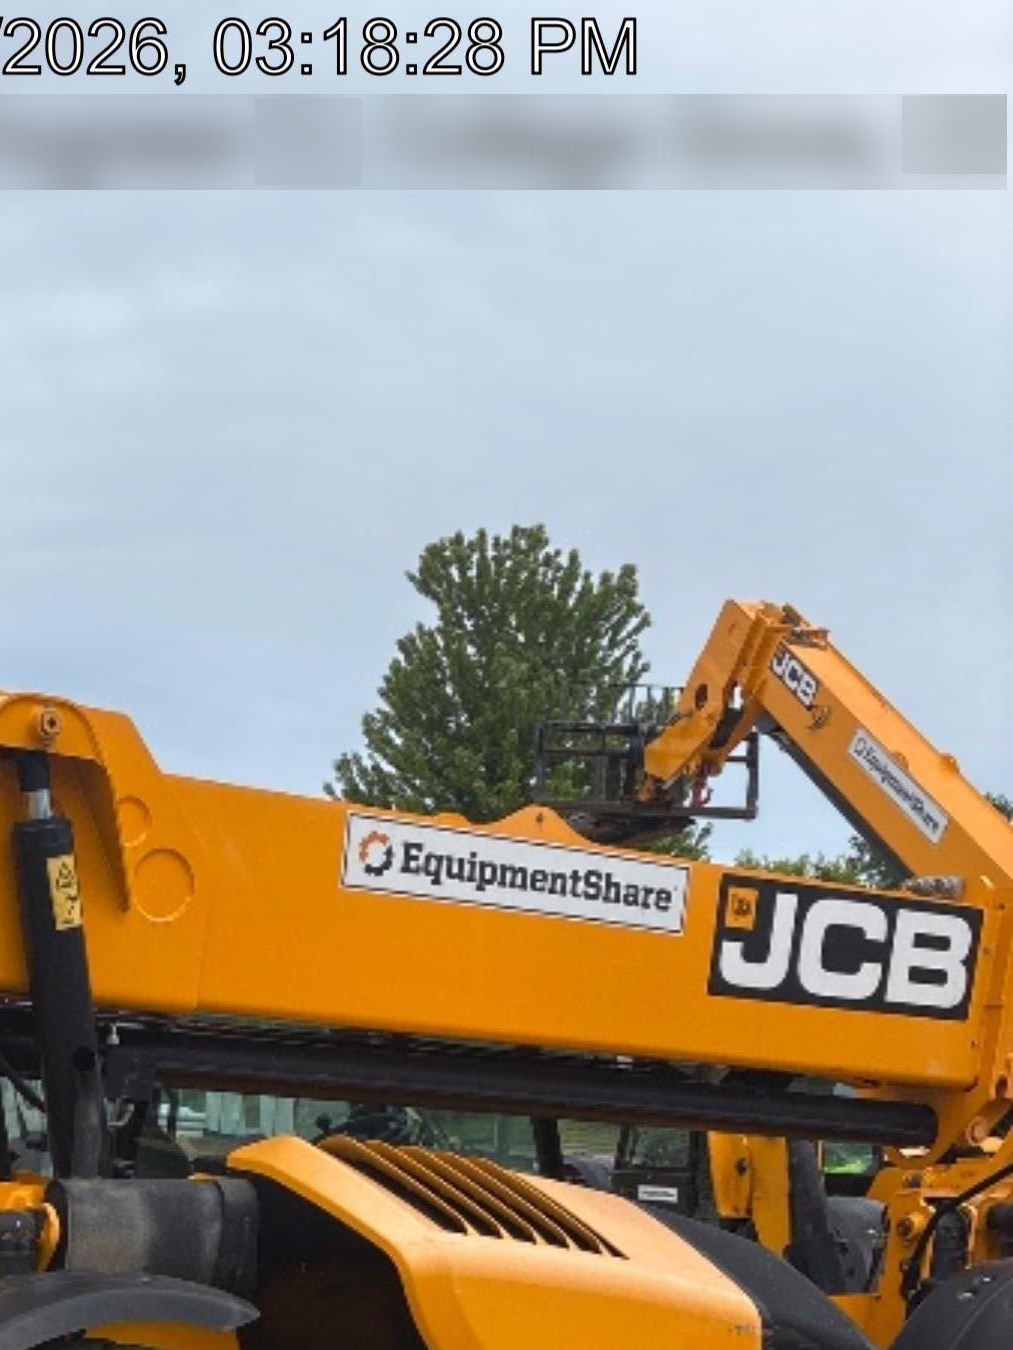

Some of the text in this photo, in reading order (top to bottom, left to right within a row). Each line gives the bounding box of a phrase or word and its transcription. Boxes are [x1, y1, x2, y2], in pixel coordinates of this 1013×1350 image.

[773, 654, 816, 706] JCB
[400, 842, 672, 912] EquipmentShare
[719, 892, 973, 1009] JCB
